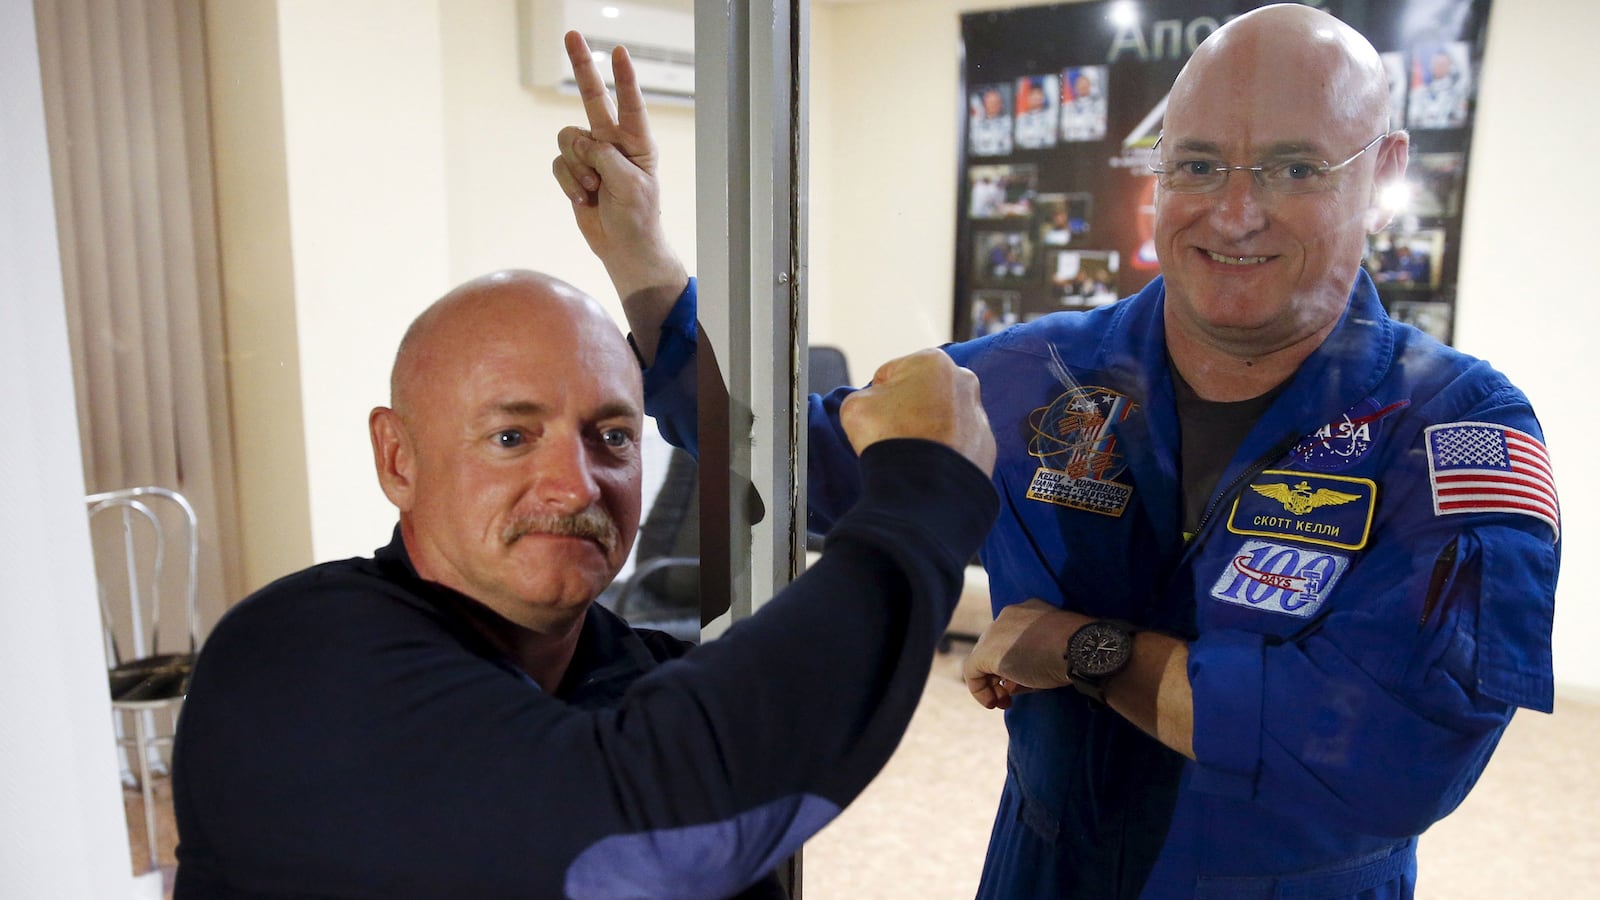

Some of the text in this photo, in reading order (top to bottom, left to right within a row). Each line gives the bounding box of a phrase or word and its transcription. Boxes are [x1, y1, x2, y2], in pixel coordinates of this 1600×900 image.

[1312, 421, 1371, 442] ASA
[1038, 471, 1064, 482] KELLY
[1253, 515, 1340, 537] СКОТТ КЕЛЛИ
[1218, 545, 1336, 611] 100
[1260, 574, 1292, 588] DAYS
